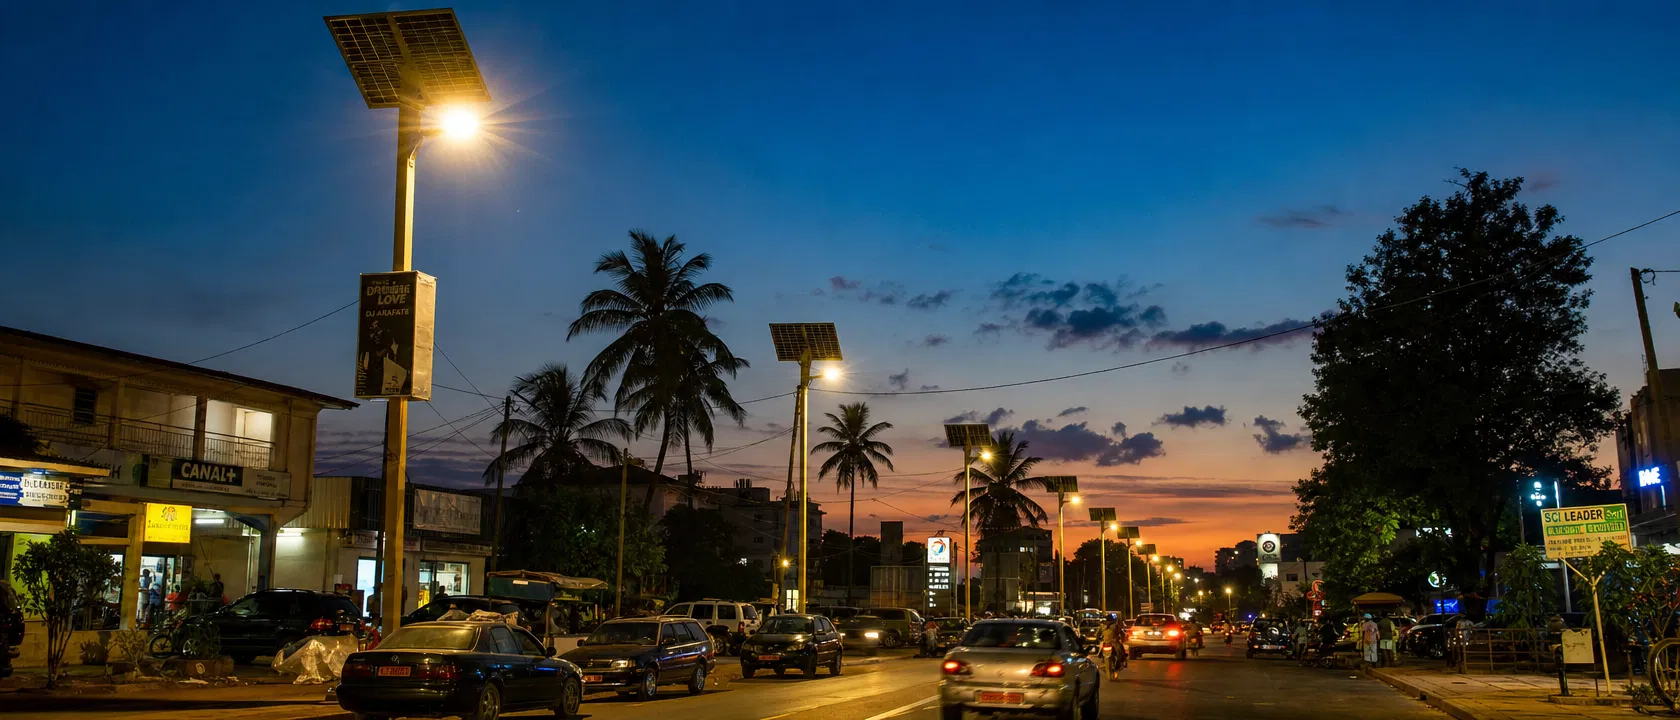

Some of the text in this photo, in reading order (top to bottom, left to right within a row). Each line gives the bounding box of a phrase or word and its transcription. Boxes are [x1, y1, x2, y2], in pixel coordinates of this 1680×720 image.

[378, 294, 406, 304] LOVE
[181, 462, 236, 482] CANAL+
[1544, 510, 1561, 523] SCI
[1564, 509, 1603, 521] LEADER
